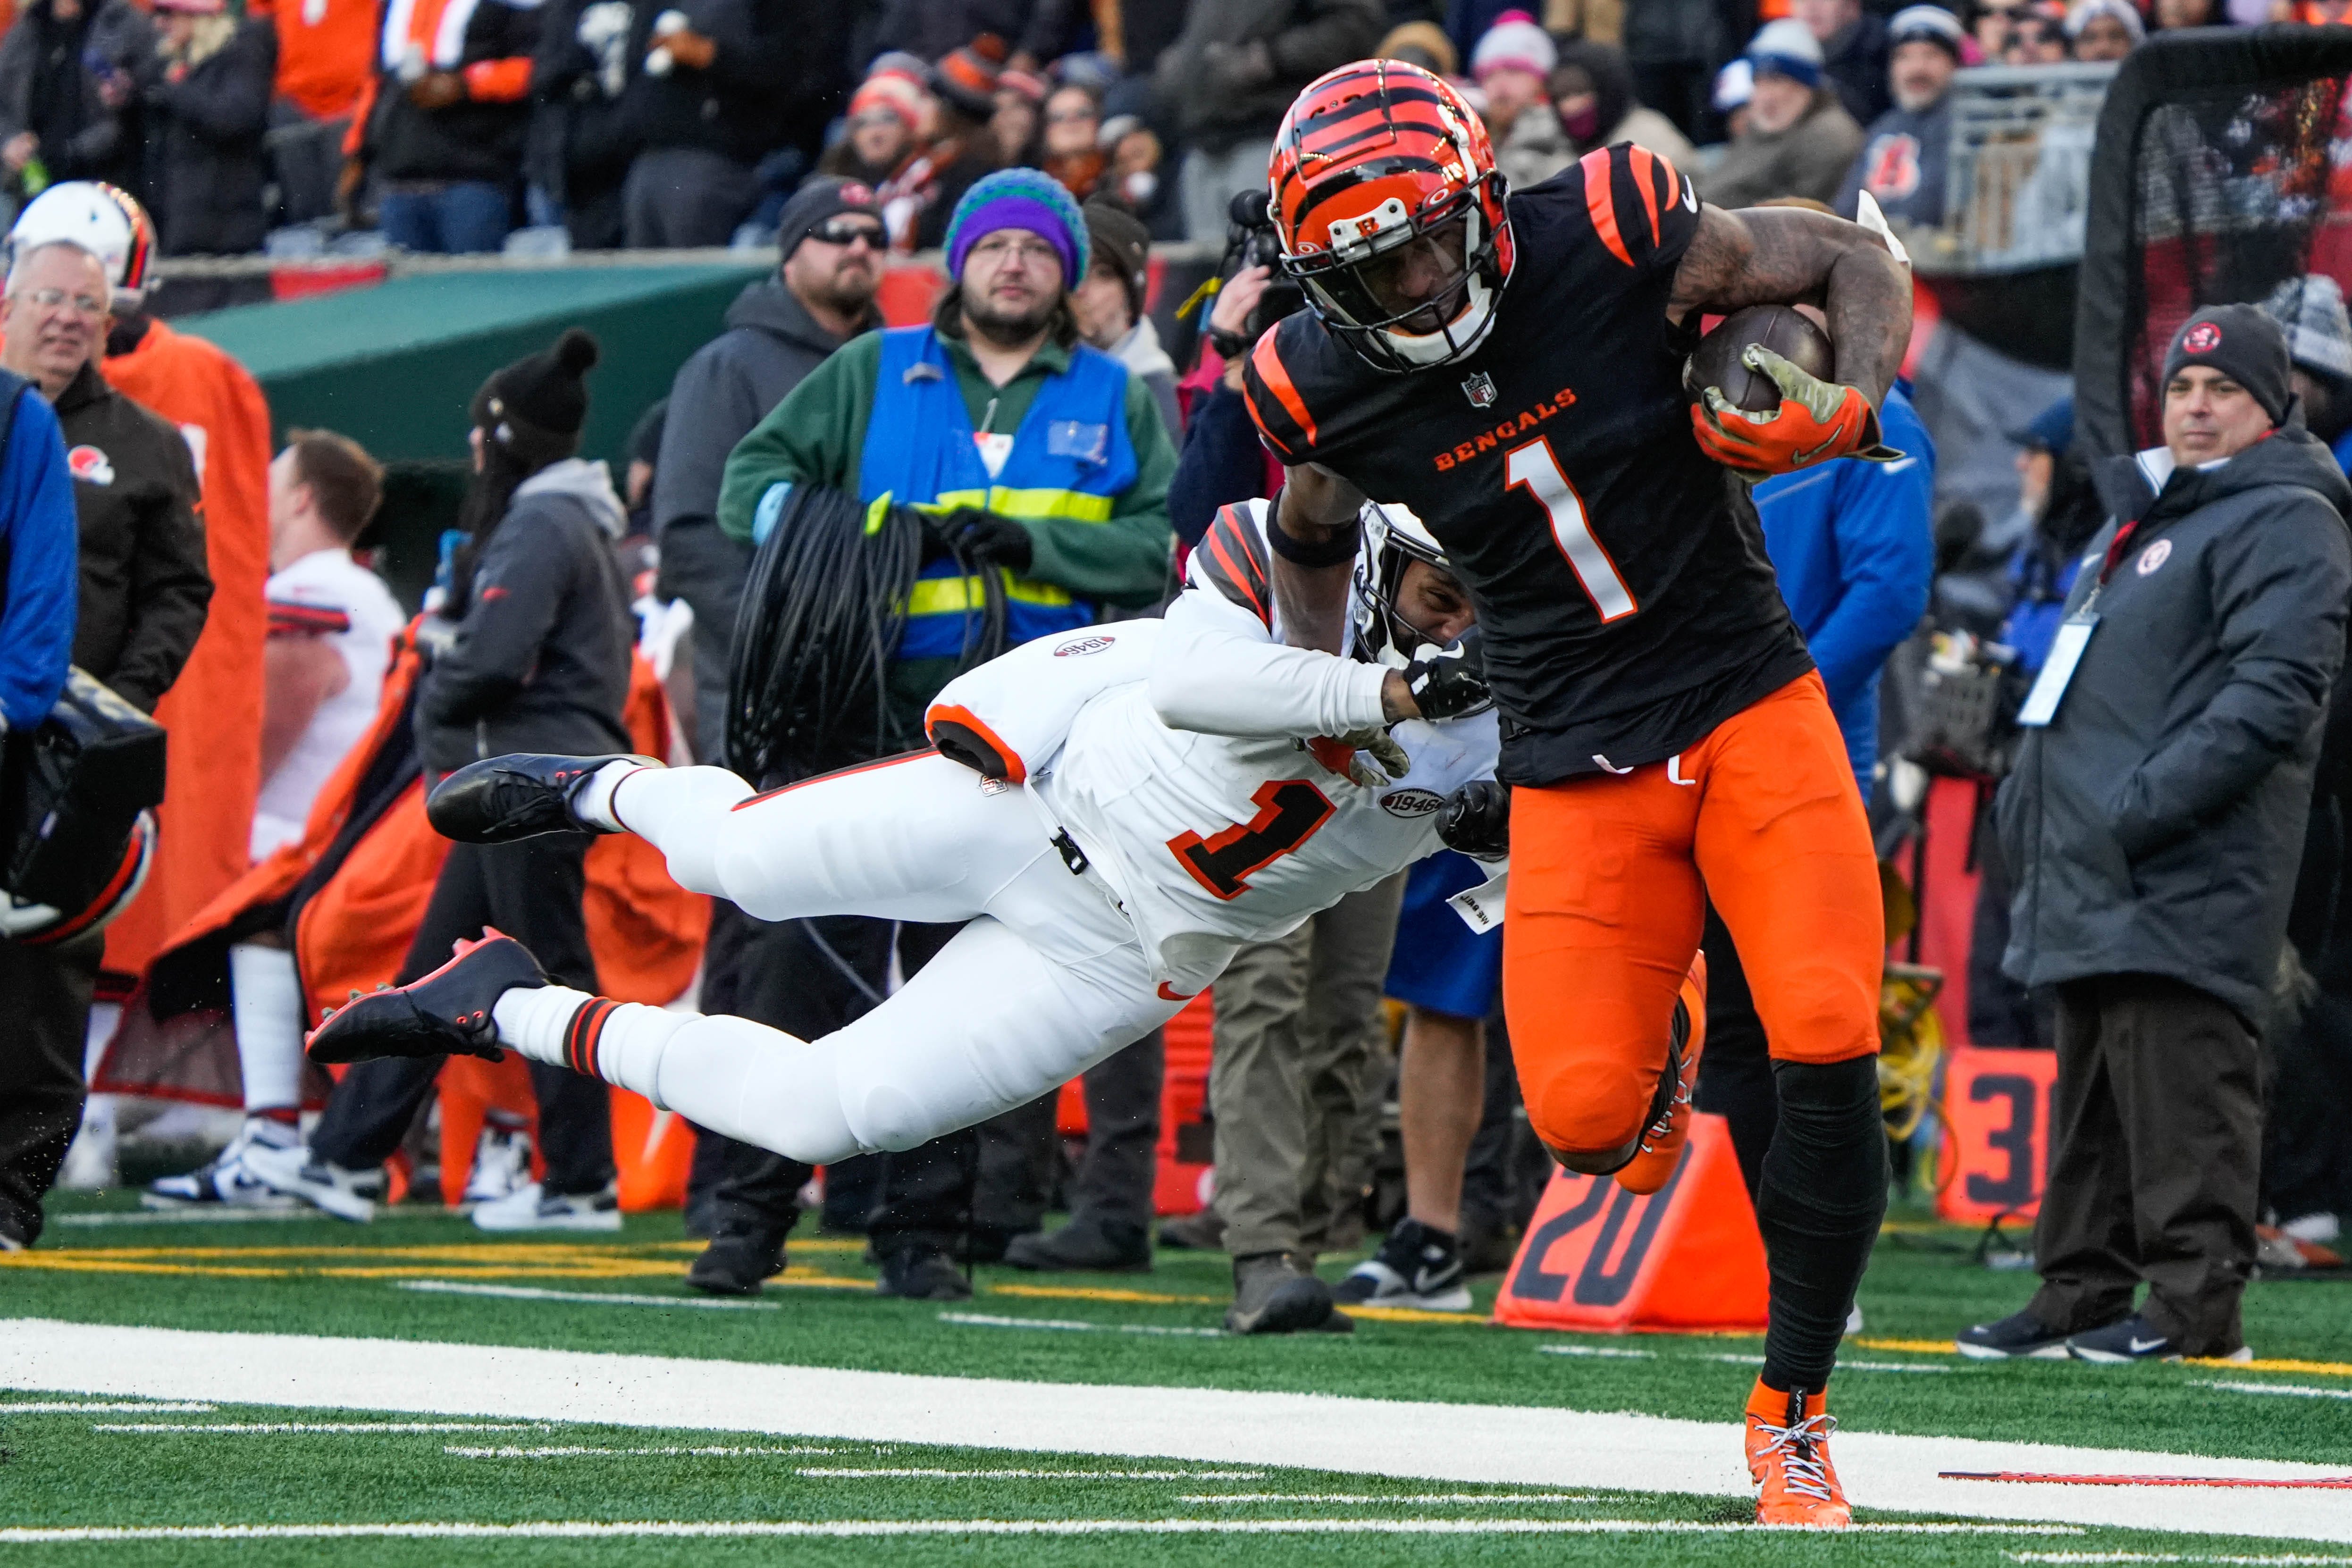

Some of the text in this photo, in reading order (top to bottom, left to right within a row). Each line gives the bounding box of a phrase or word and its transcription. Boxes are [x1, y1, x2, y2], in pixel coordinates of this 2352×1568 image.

[1434, 387, 1577, 471] BENGALS
[1470, 384, 1494, 403] NFL
[1504, 434, 1638, 624] 1
[1063, 639, 1107, 654] 1946
[1165, 779, 1338, 901] 1
[1391, 794, 1439, 812] 1946
[1966, 1073, 2055, 1206] 3
[1511, 1139, 1693, 1307] 20
